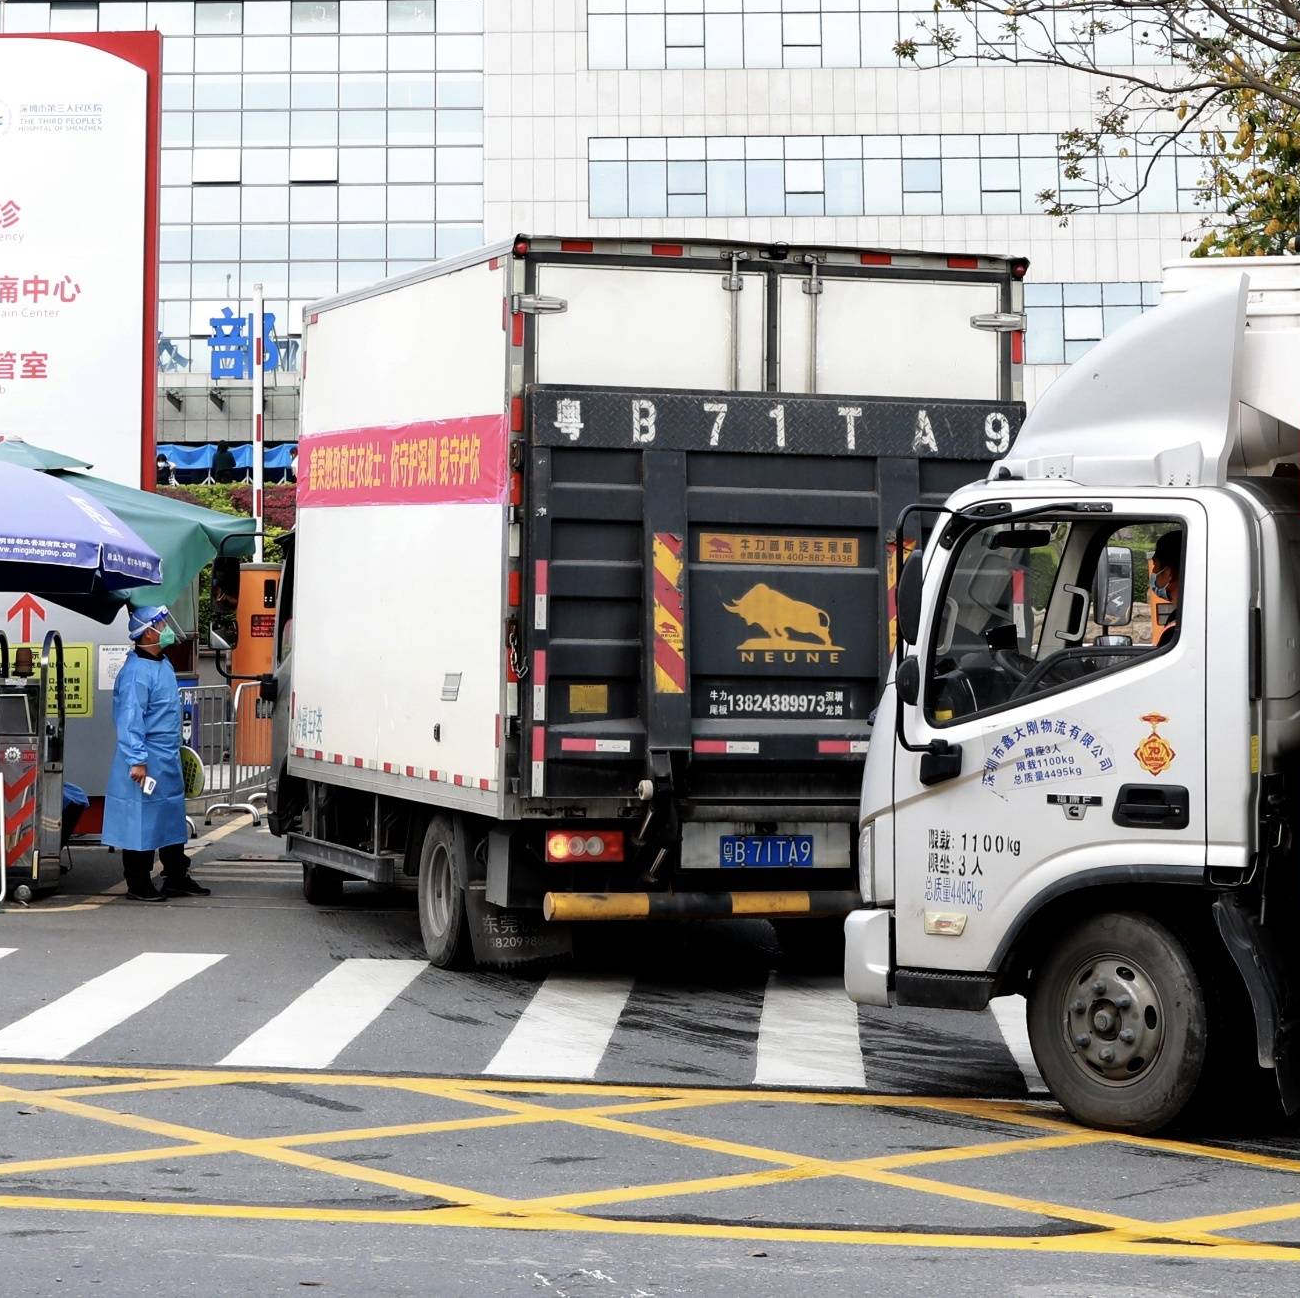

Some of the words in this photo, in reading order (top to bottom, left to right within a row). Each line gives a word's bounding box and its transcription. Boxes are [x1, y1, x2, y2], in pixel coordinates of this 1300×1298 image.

[21, 307, 60, 318] Center
[740, 651, 840, 663] NEUNE
[709, 689, 728, 701] 牛力
[825, 690, 844, 702] 深圳
[727, 693, 826, 713] 13824389973
[1015, 755, 1075, 773] 限载1100kg
[1013, 766, 1083, 786] 总质量4495kg
